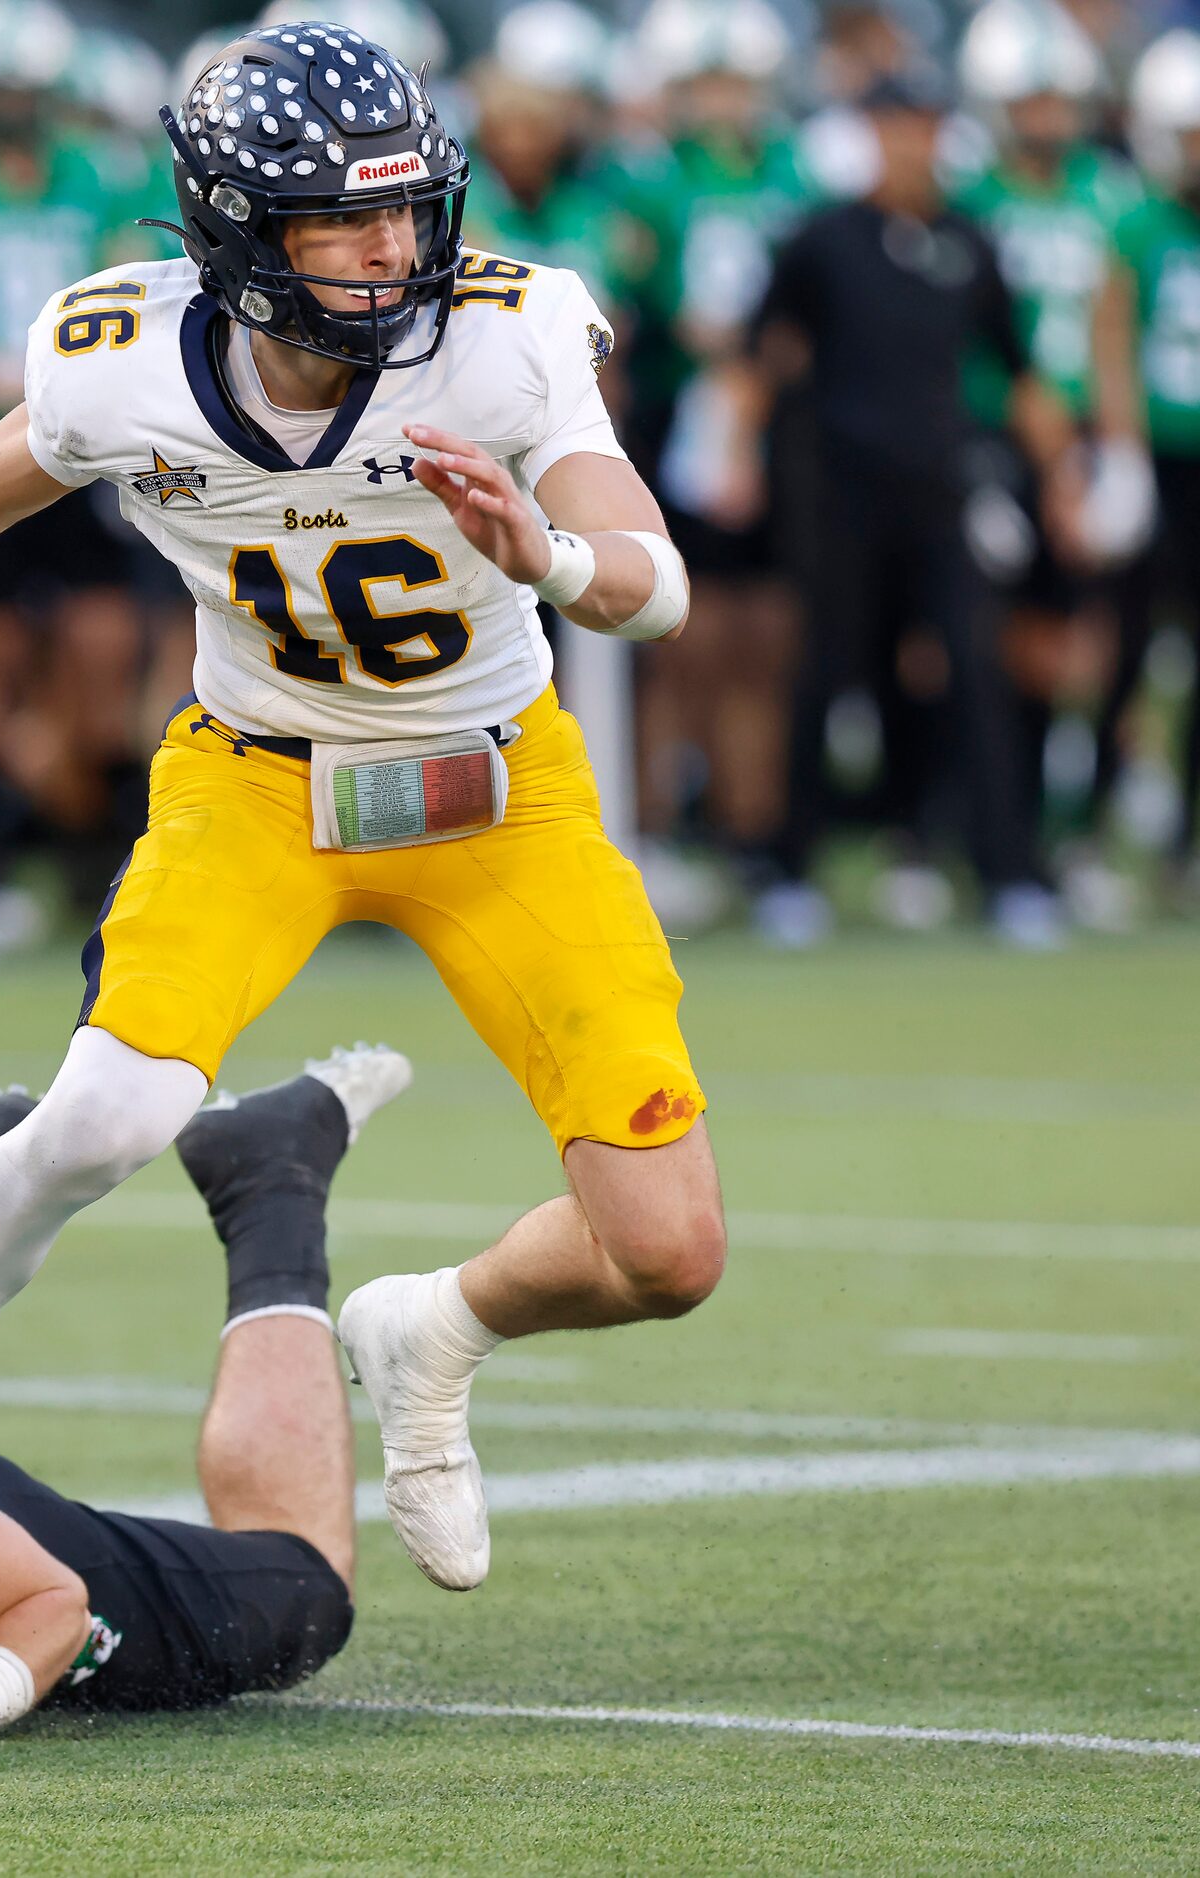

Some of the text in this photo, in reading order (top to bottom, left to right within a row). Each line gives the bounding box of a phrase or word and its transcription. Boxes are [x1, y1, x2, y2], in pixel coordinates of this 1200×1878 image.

[358, 156, 420, 181] Riddell
[450, 253, 537, 314] 16
[53, 279, 147, 359] 16
[284, 506, 349, 531] Scots
[227, 533, 474, 690] 16
